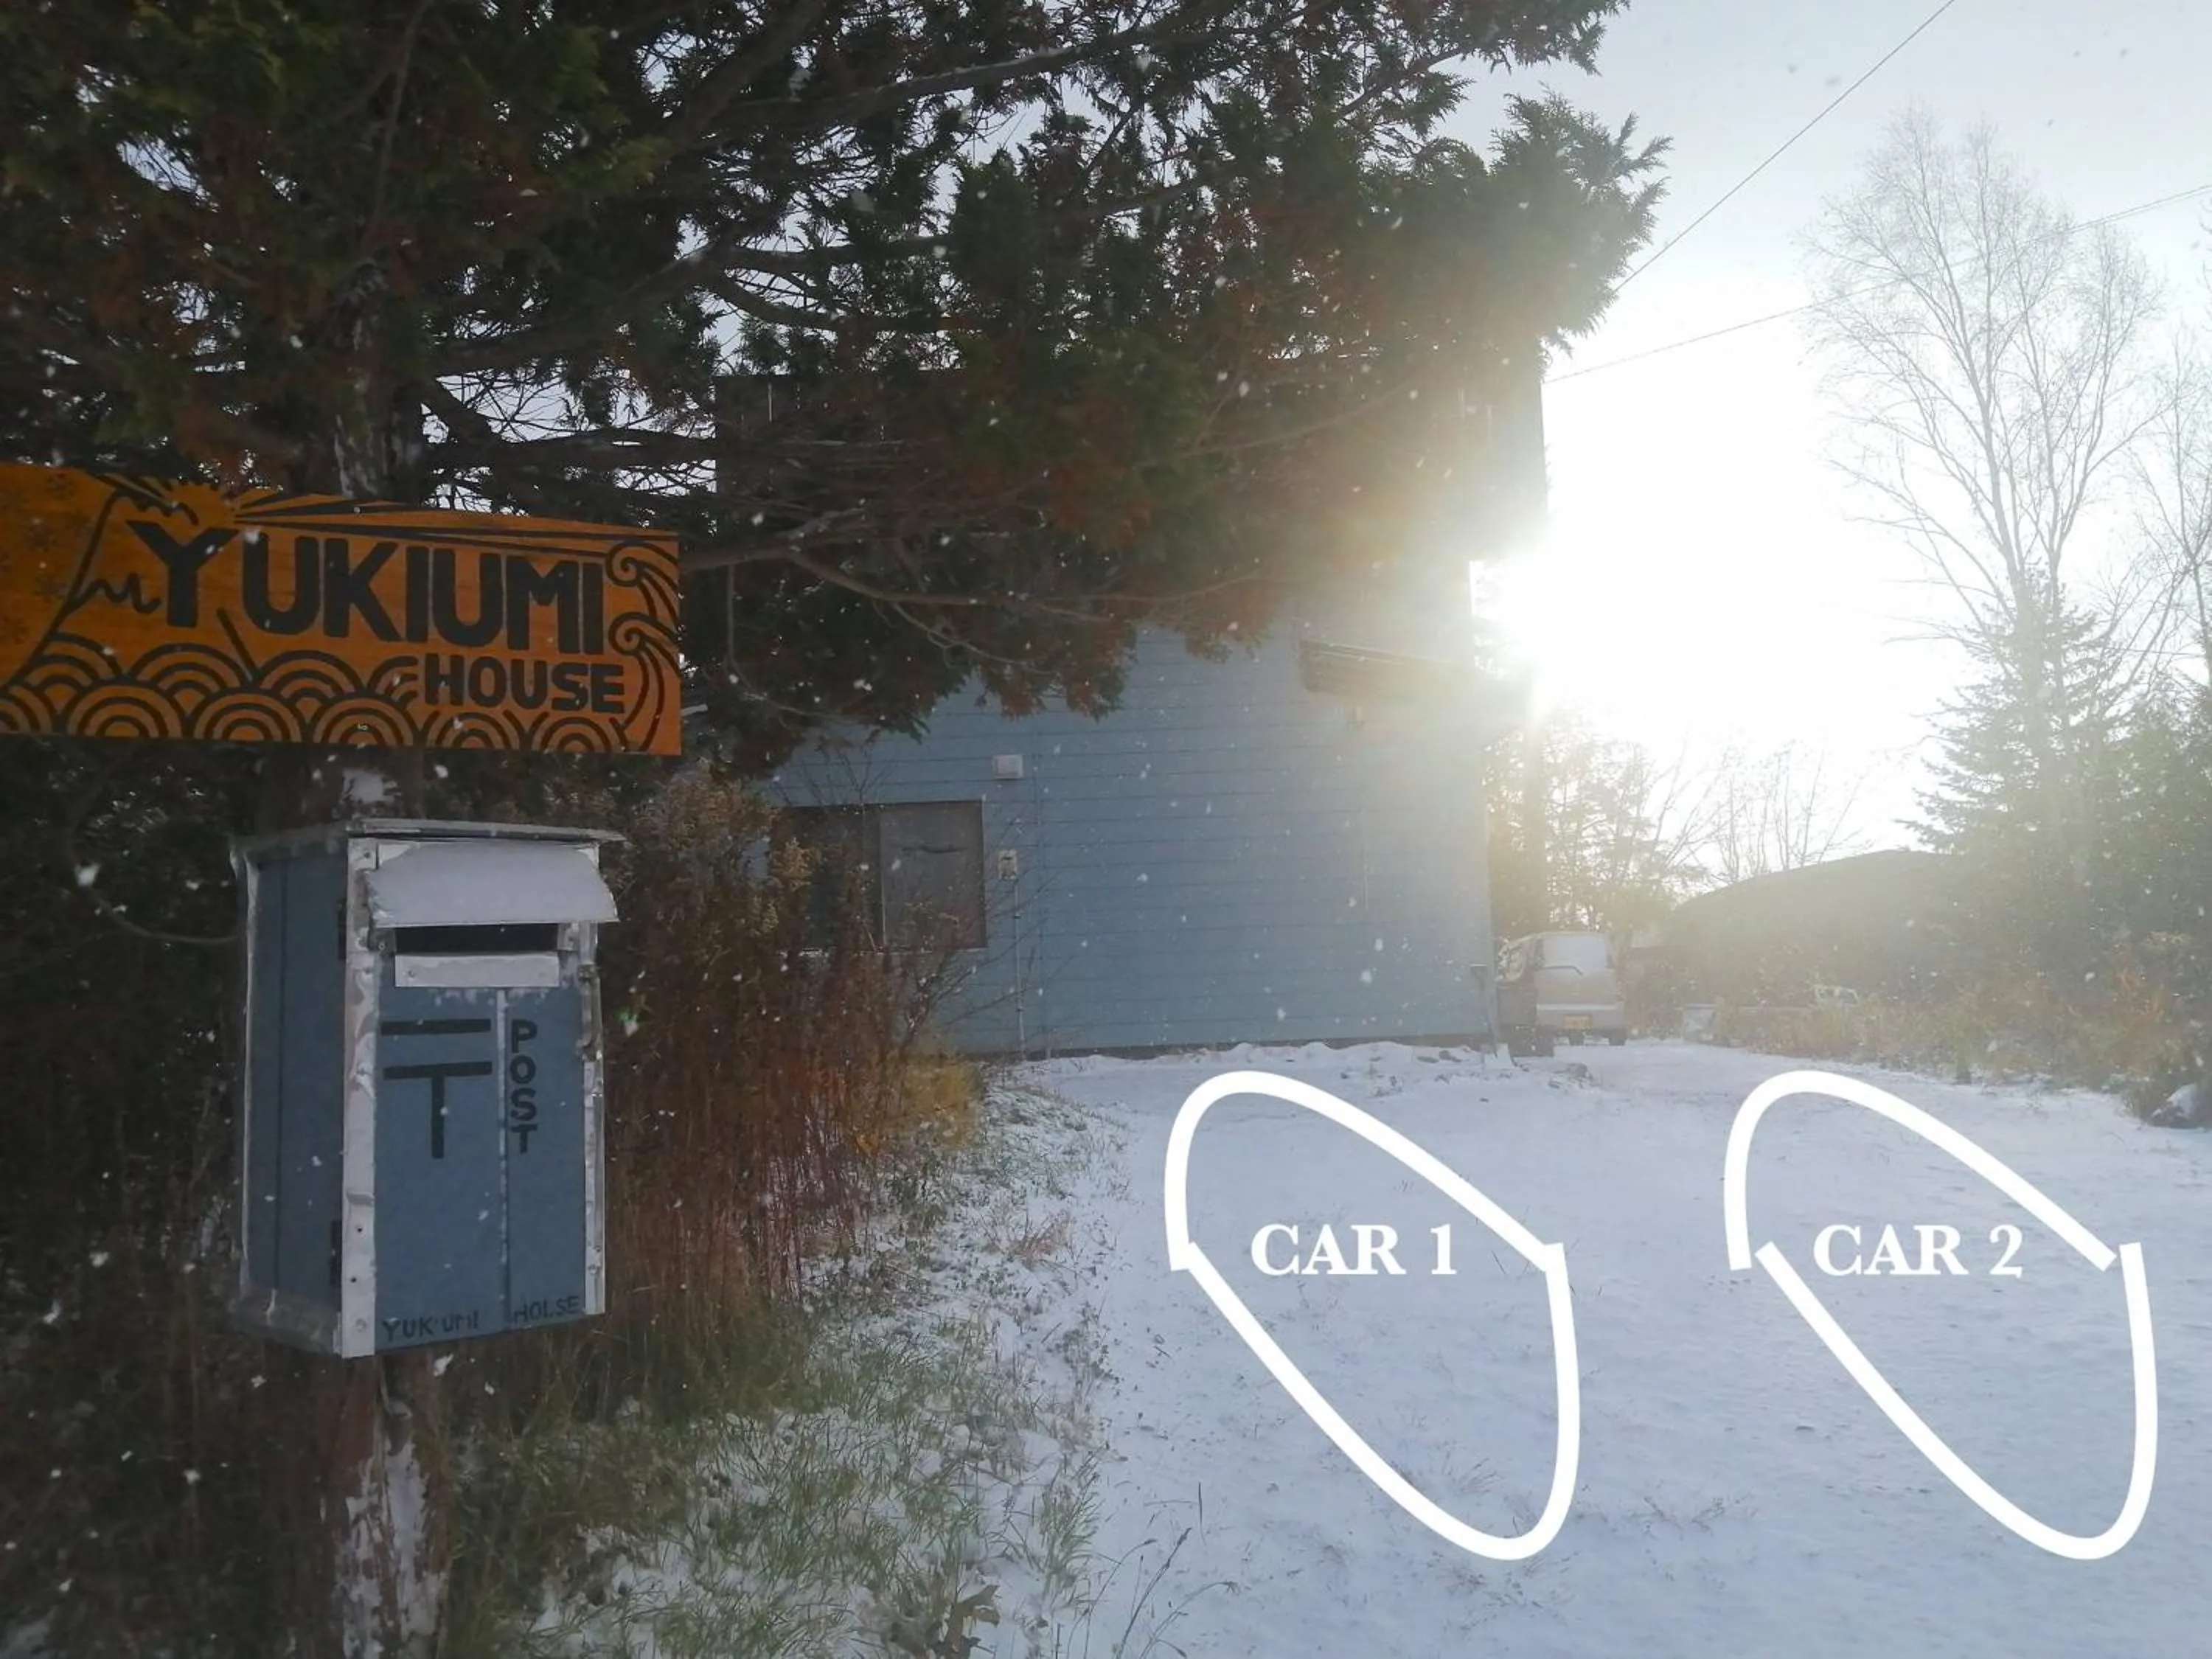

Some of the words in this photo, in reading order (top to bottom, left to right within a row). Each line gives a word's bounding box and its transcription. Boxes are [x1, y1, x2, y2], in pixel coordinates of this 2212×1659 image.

[128, 521, 608, 654] YUKIUMI
[425, 654, 625, 714] HOUSE
[509, 1020, 538, 1153] POST
[382, 1310, 479, 1342] YUKUMI
